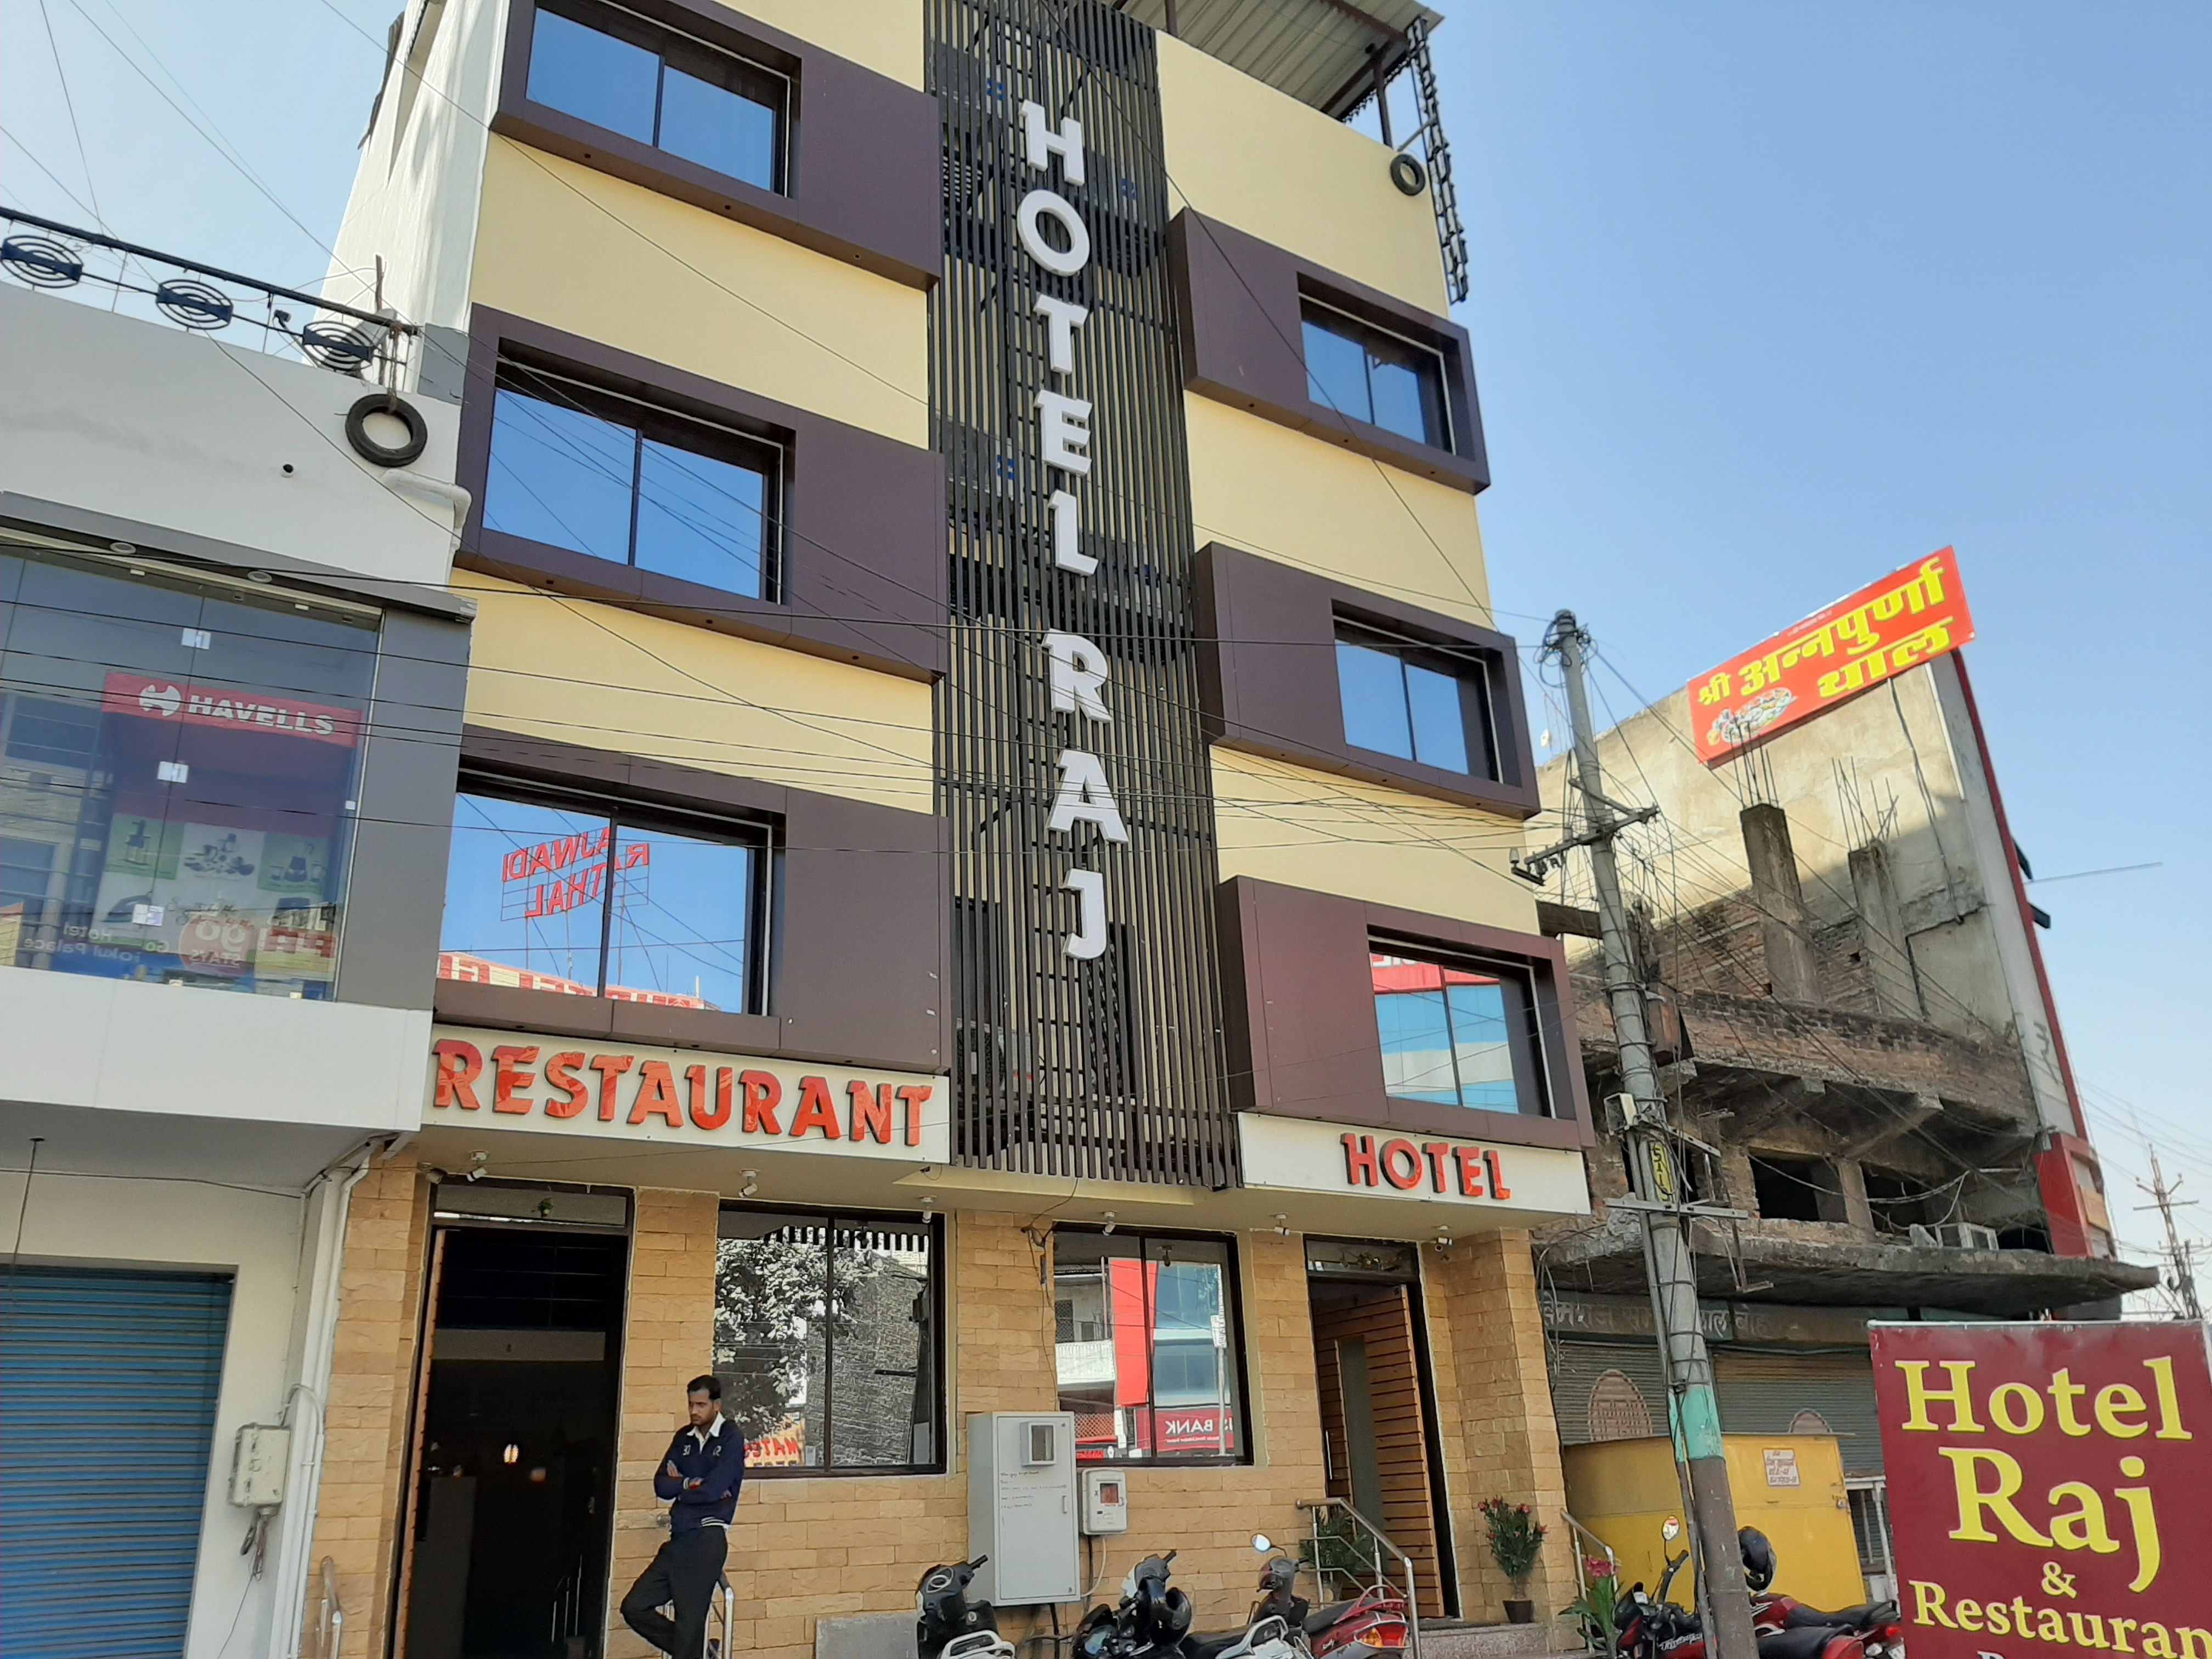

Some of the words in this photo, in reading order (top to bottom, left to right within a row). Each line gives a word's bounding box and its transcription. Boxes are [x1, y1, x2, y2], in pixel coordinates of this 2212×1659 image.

[1017, 99, 1098, 576] HOTEL
[188, 695, 335, 735] HAVELLS
[1698, 672, 1732, 706] श्री
[1042, 628, 1129, 960] RAJ
[432, 1039, 934, 1147] RESTAURANT
[1340, 1132, 1511, 1200] HOTEL
[1894, 1355, 2193, 1441] Hotel
[1938, 1446, 2162, 1592] Raj
[2041, 1560, 2078, 1599] &
